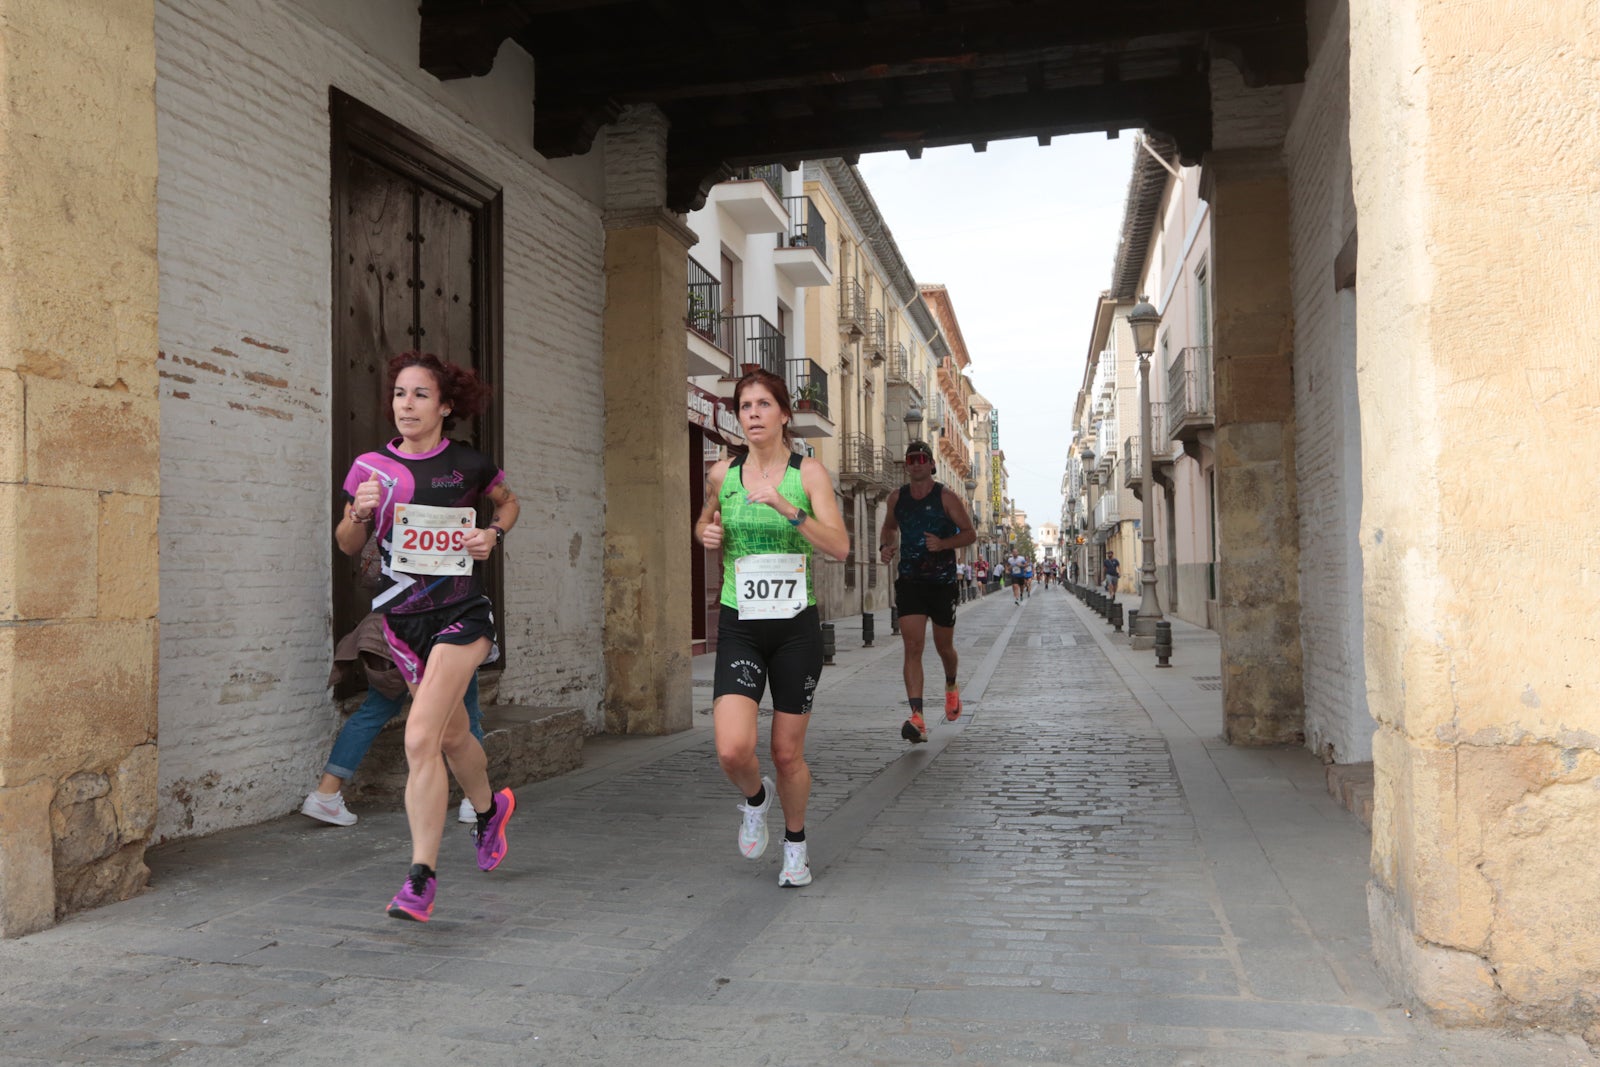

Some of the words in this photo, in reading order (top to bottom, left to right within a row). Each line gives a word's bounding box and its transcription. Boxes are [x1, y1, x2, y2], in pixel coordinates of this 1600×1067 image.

[431, 481, 455, 489] SANTA
[402, 528, 464, 552] 2099
[743, 579, 798, 600] 3077
[730, 660, 762, 674] RUNNING
